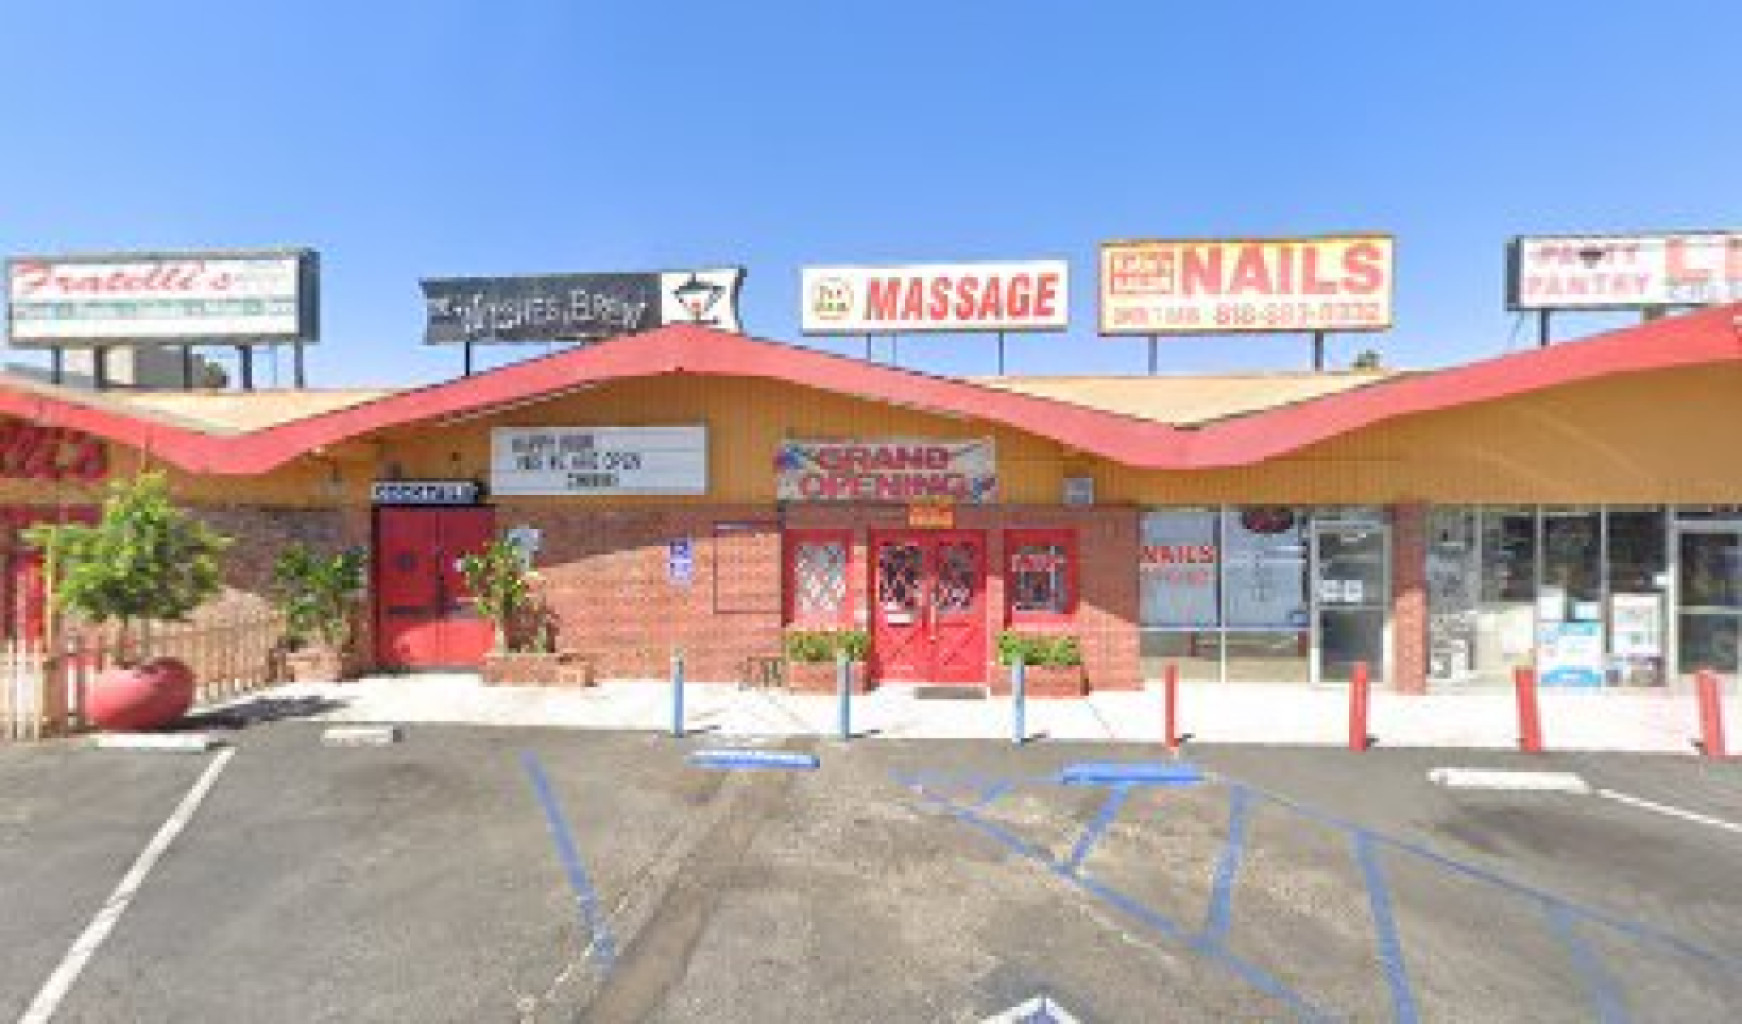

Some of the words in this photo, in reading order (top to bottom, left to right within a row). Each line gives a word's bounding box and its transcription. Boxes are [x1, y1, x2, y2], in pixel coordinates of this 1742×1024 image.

[12, 258, 234, 294] Fratelli's
[1181, 242, 1384, 295] NAILS
[1524, 272, 1651, 295] PANTRY
[863, 273, 1060, 321] MASSAGE
[819, 446, 950, 470] GRAND
[799, 475, 968, 500] OPENING
[1140, 545, 1214, 564] NAILS
